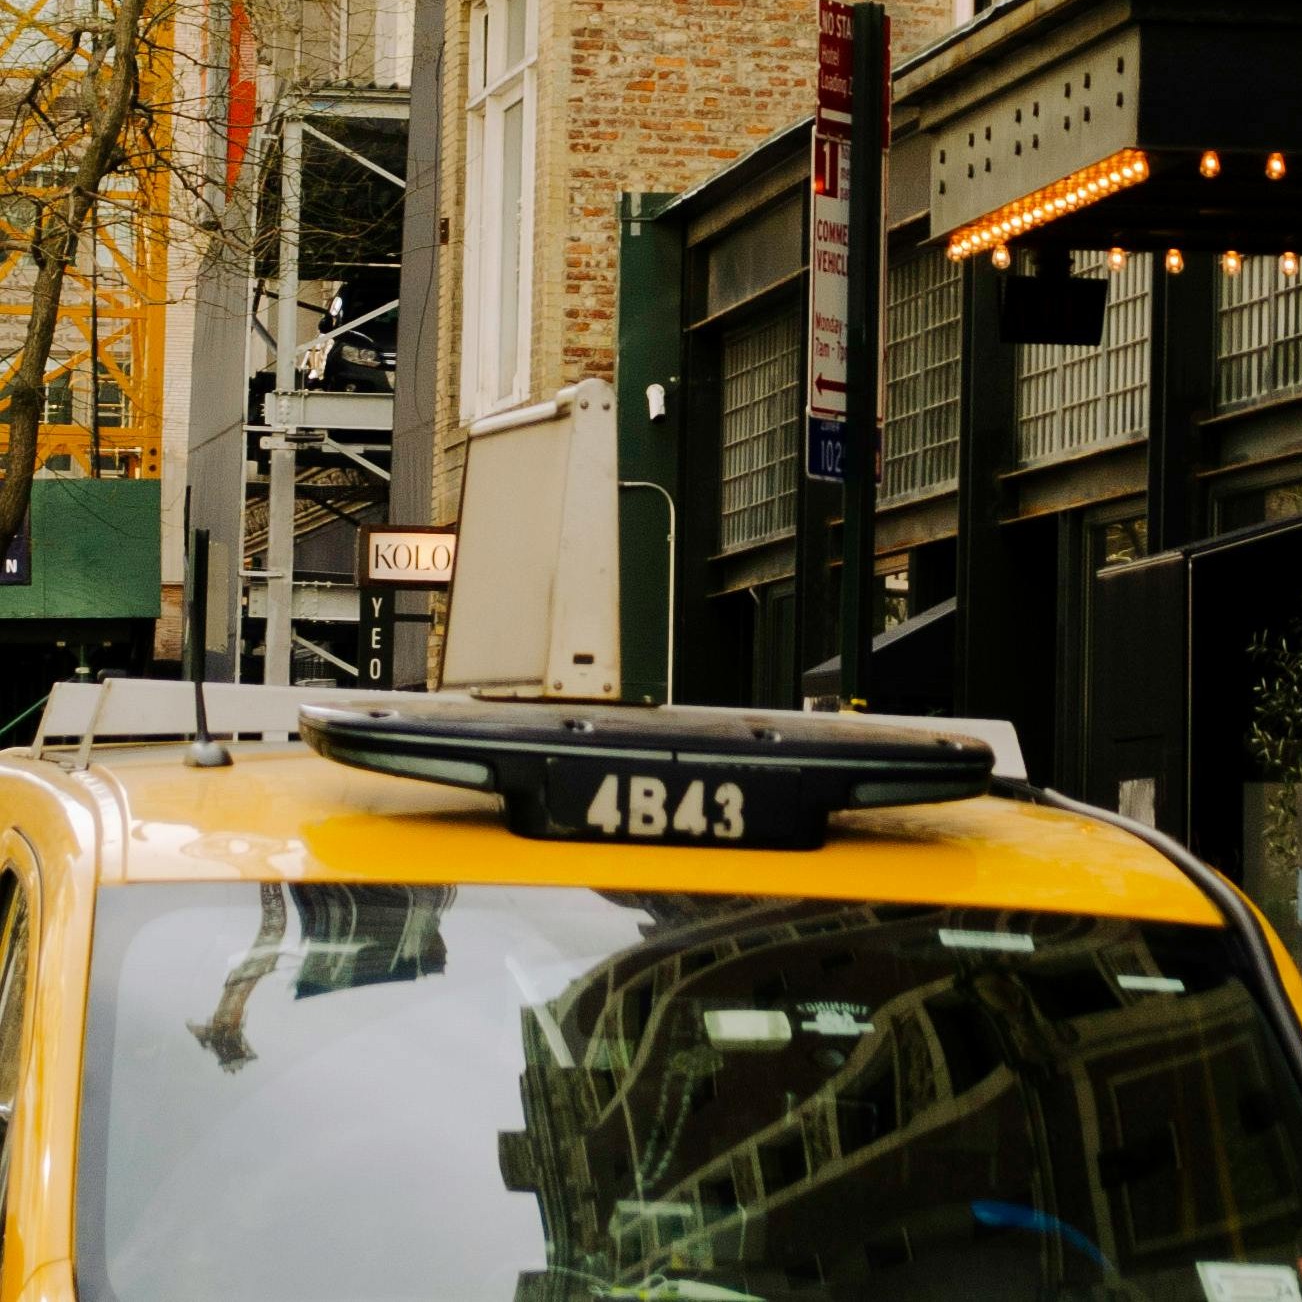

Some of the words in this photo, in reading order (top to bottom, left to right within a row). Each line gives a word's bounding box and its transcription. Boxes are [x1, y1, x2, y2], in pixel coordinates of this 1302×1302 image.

[821, 10, 835, 35] NO
[836, 13, 854, 40] STA
[821, 44, 840, 66] Hotel
[820, 69, 847, 98] Loading
[816, 219, 848, 247] COMME
[816, 249, 848, 276] VEHICL
[815, 312, 843, 336] Monday
[820, 440, 843, 473] 102
[374, 543, 451, 571] KOLO
[587, 774, 744, 837] 4B43
